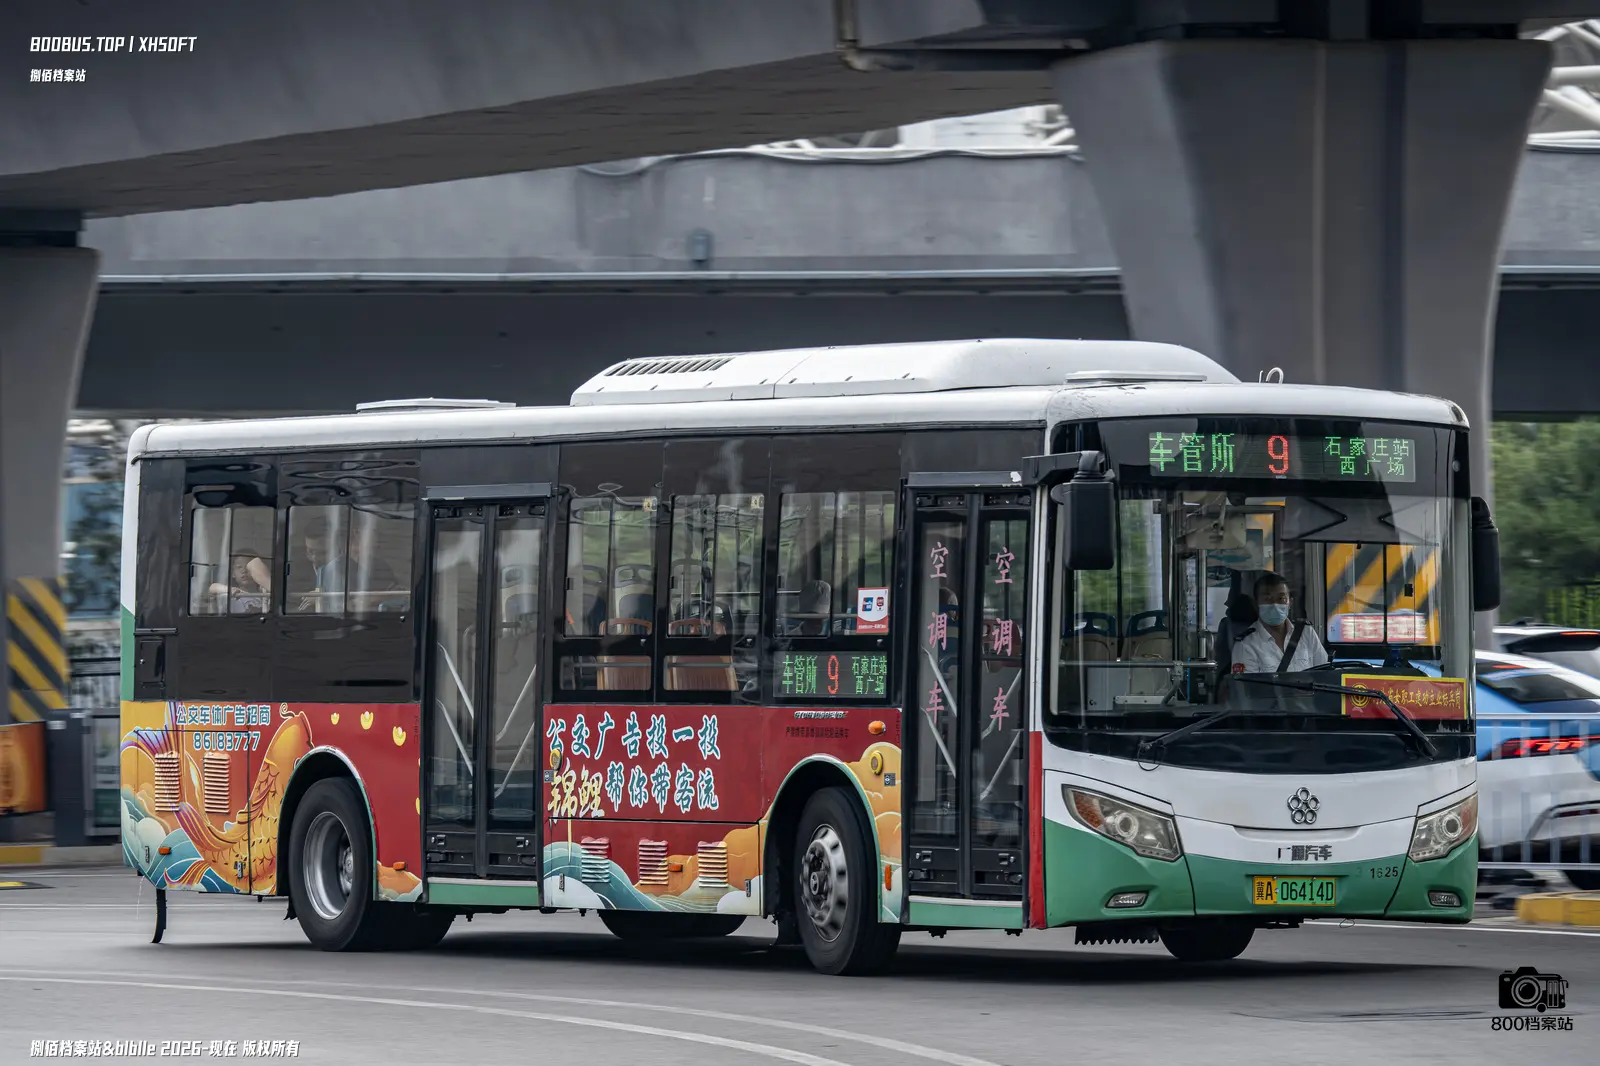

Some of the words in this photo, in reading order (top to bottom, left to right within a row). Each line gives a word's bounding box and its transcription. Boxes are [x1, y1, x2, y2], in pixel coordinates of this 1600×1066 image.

[1149, 432, 1235, 473] 车管所
[1267, 435, 1289, 474] 9
[1324, 436, 1409, 457] 石家庄站
[1339, 456, 1405, 475] 西广场
[926, 541, 949, 725] 空调车
[989, 546, 1015, 732] 空调车
[782, 654, 818, 694] 车管所
[827, 655, 839, 695] 9
[851, 655, 888, 676] 石家庄站
[855, 675, 885, 695] 西广场
[176, 705, 271, 726] 公交车体广告招商
[193, 731, 261, 751] 86183777
[546, 711, 721, 760] 公交广告投一投
[1370, 866, 1399, 879] 1625
